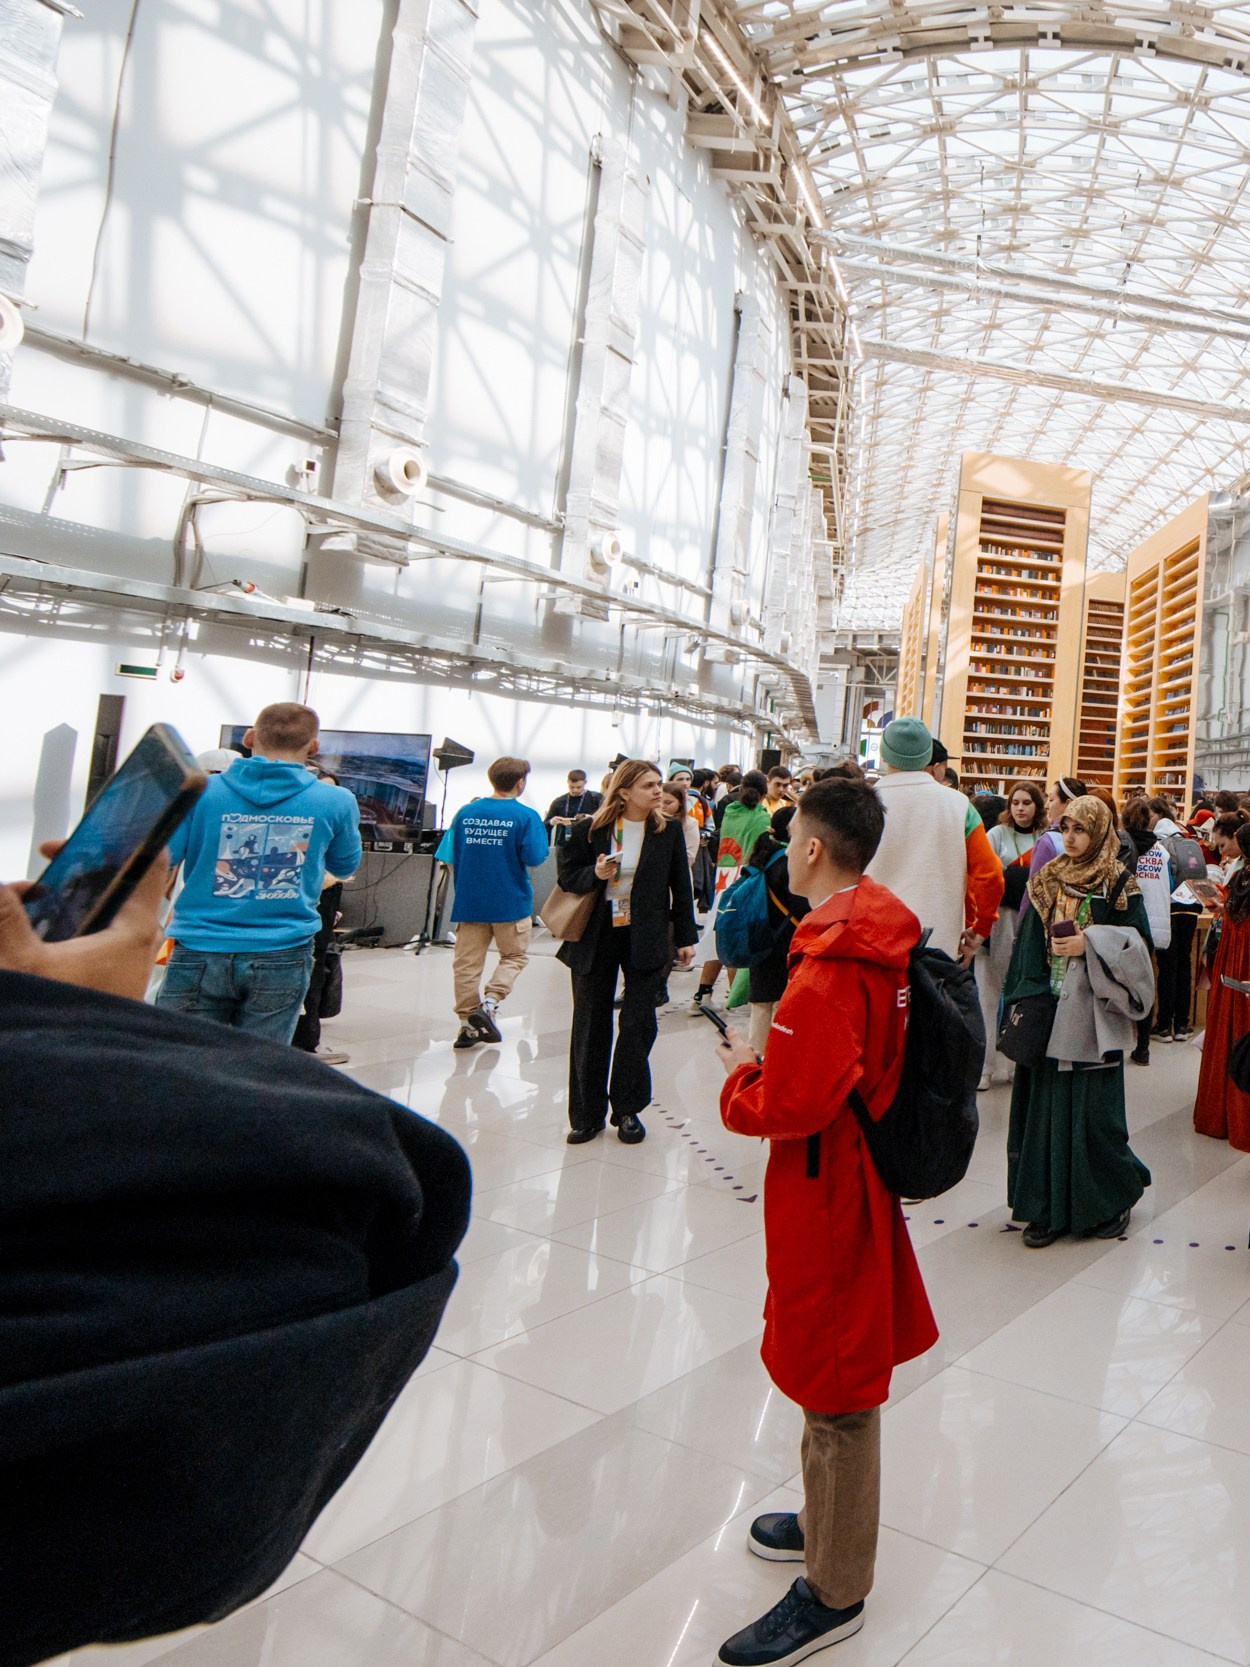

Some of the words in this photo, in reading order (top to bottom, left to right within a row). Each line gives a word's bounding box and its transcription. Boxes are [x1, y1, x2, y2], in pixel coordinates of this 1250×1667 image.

[462, 818, 514, 828] СОЗДАВАЯ
[464, 828, 509, 837] БУДУЩЕЕ
[466, 837, 503, 846] ВМЕСТЕ
[1138, 856, 1164, 866] СКВА
[1137, 864, 1162, 873] SCOW
[1134, 871, 1160, 880] ОСКВА
